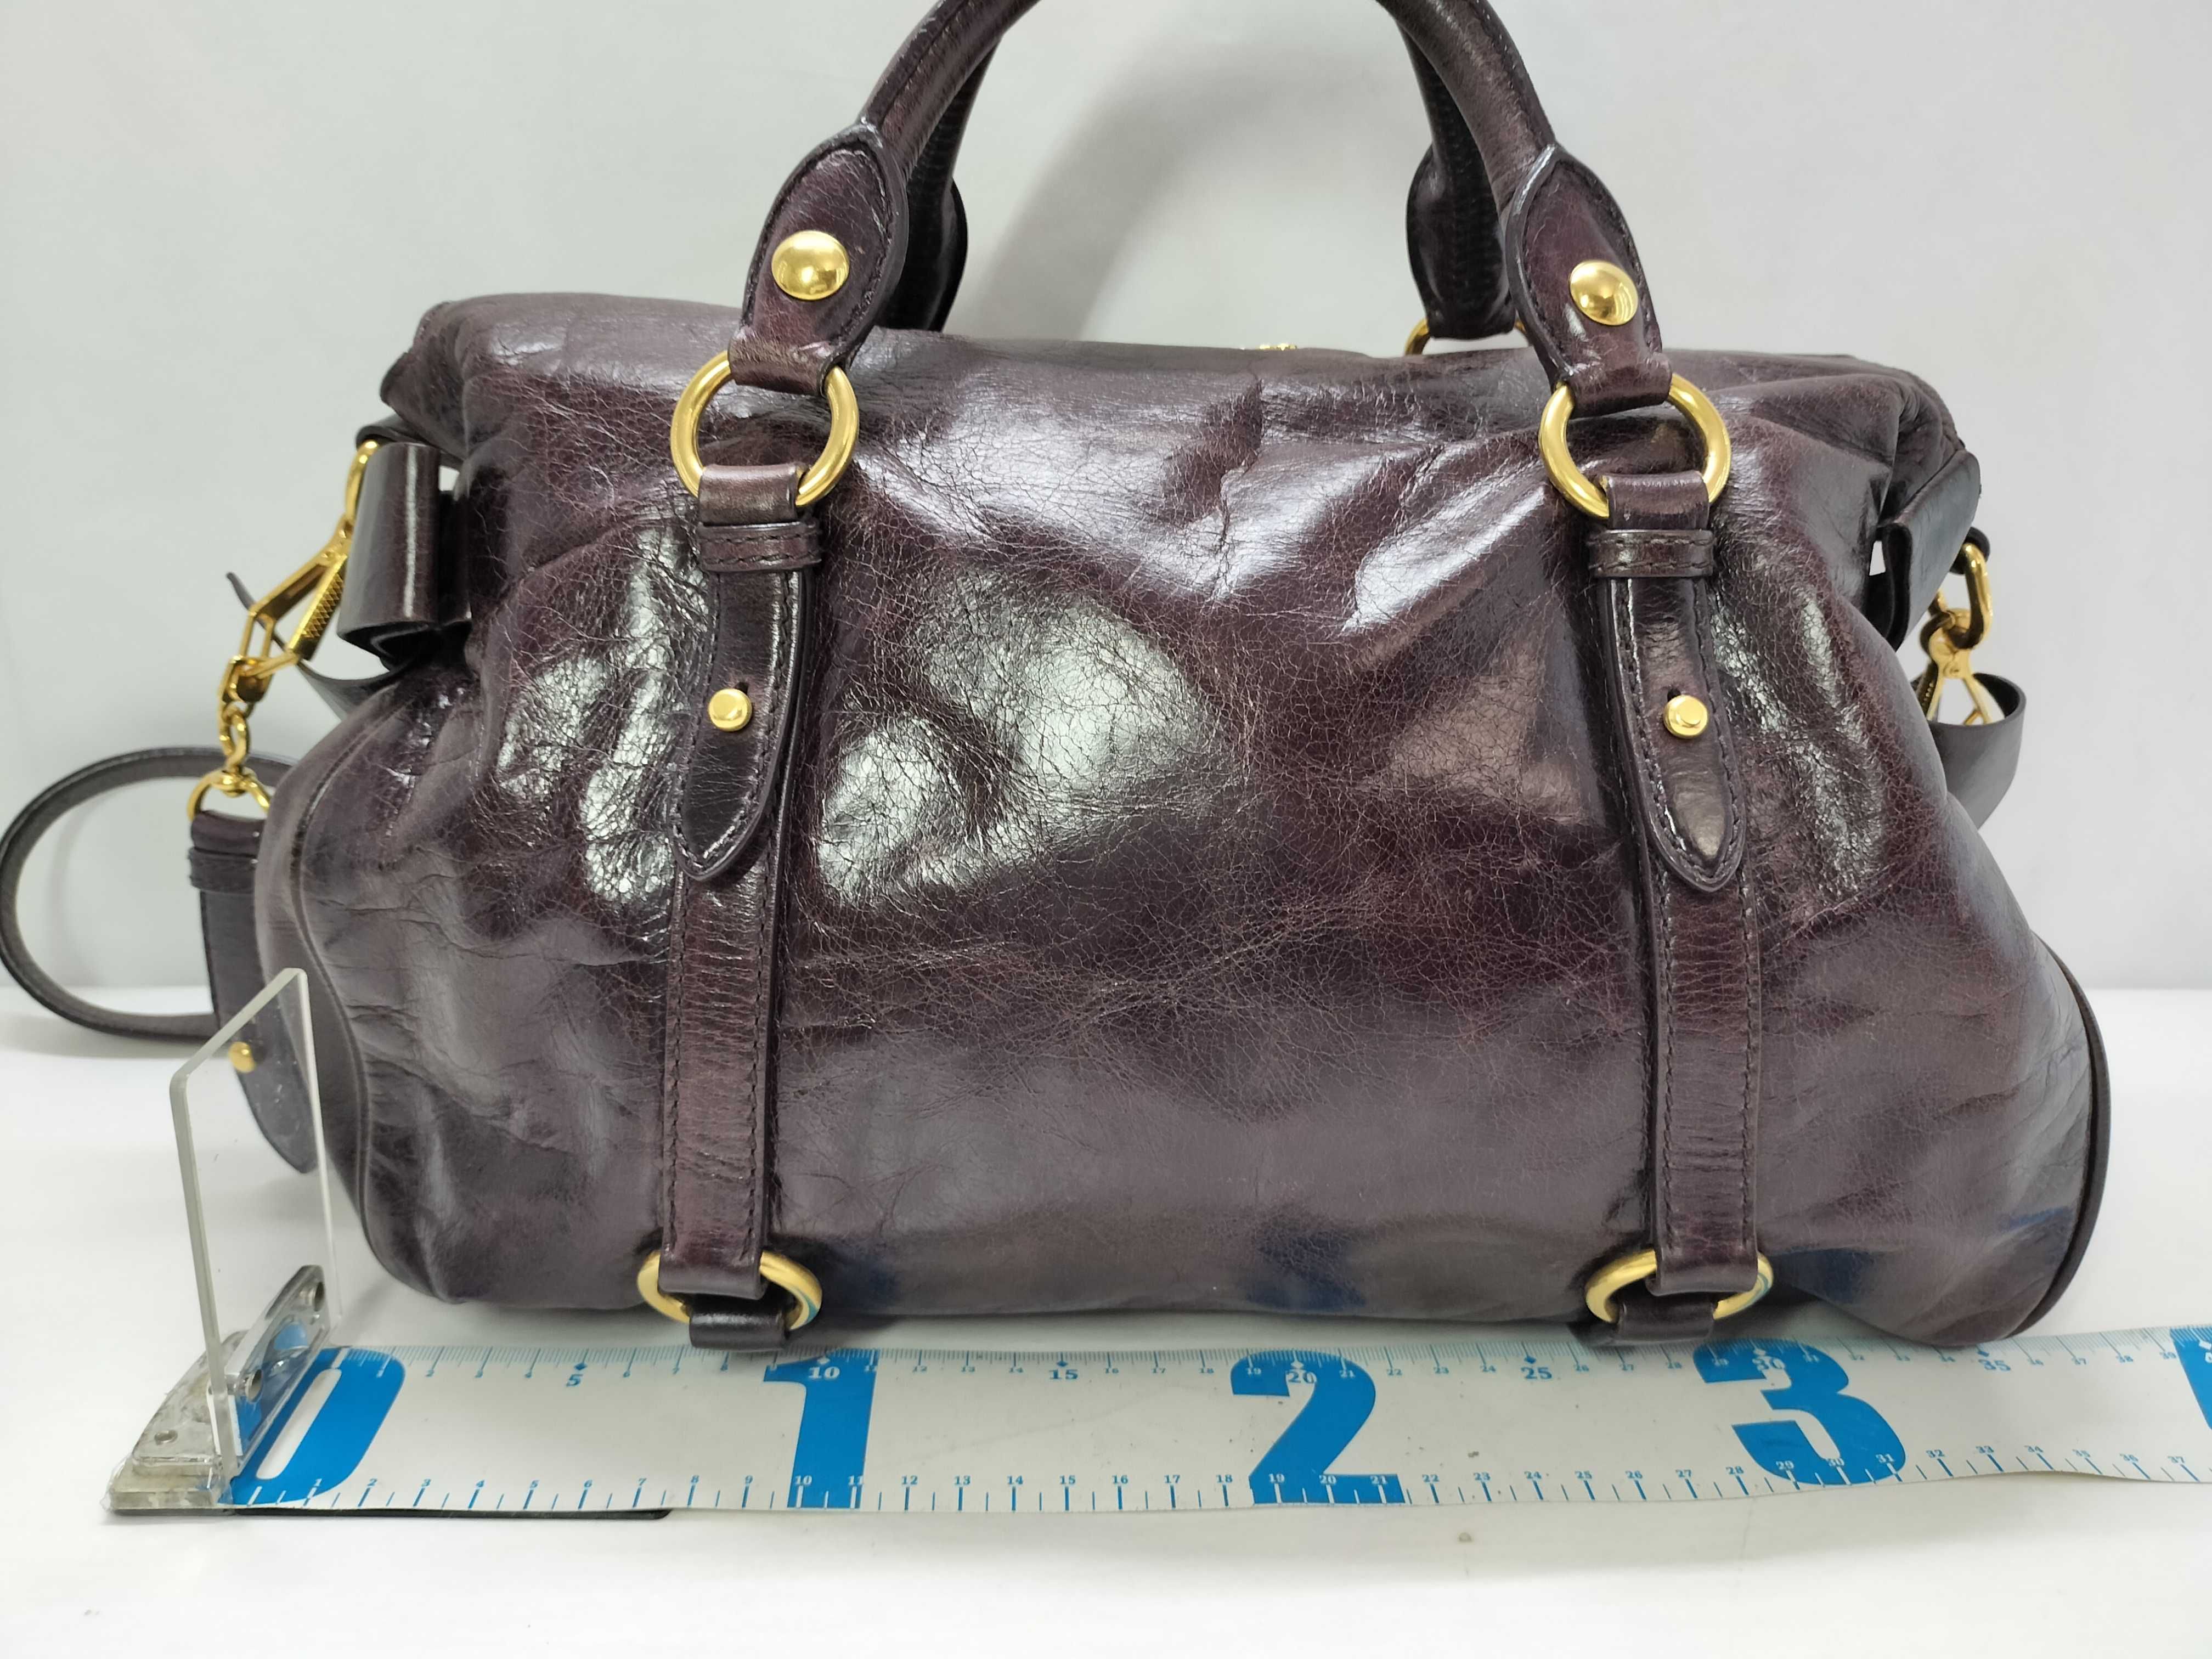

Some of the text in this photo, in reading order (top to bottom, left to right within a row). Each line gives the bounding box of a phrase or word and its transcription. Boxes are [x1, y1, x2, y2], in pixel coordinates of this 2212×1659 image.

[566, 1374, 583, 1387] 5
[808, 1366, 840, 1379] 10
[1049, 1369, 1078, 1380] 15
[1289, 1372, 1314, 1384] 20
[1521, 1367, 1552, 1379] 25
[1752, 1356, 1785, 1371] 30
[1978, 1359, 2011, 1370] 35
[225, 1338, 1905, 1508] 0 1 2 3
[313, 1479, 322, 1487] 1
[368, 1479, 377, 1487] 2
[744, 1476, 753, 1484] 9
[795, 1475, 812, 1485] 10
[847, 1475, 864, 1485] 11
[901, 1476, 918, 1485] 12
[954, 1476, 970, 1485] 13
[1007, 1476, 1024, 1485] 14
[1059, 1475, 1076, 1485] 15
[1111, 1475, 1128, 1484] 16
[1164, 1474, 1181, 1484] 17
[1216, 1474, 1233, 1483] 18
[1268, 1474, 1285, 1483] 19
[1319, 1475, 1336, 1485] 20
[1372, 1475, 1388, 1484] 21
[1422, 1474, 1440, 1483] 22
[1474, 1472, 1491, 1481] 23
[1525, 1471, 1542, 1480] 24
[1575, 1471, 1593, 1480] 25
[1626, 1471, 1643, 1479] 26
[1675, 1469, 1693, 1478] 27
[1726, 1466, 1743, 1475] 28
[1776, 1460, 1794, 1470] 29
[1826, 1458, 1844, 1466] 30
[1875, 1453, 1895, 1463] 31
[1926, 1449, 1945, 1458] 32
[1976, 1446, 1994, 1454] 33
[2024, 1445, 2044, 1453] 34
[2072, 1449, 2091, 1458] 35
[2120, 1453, 2139, 1462] 36
[2168, 1455, 2185, 1464] 37
